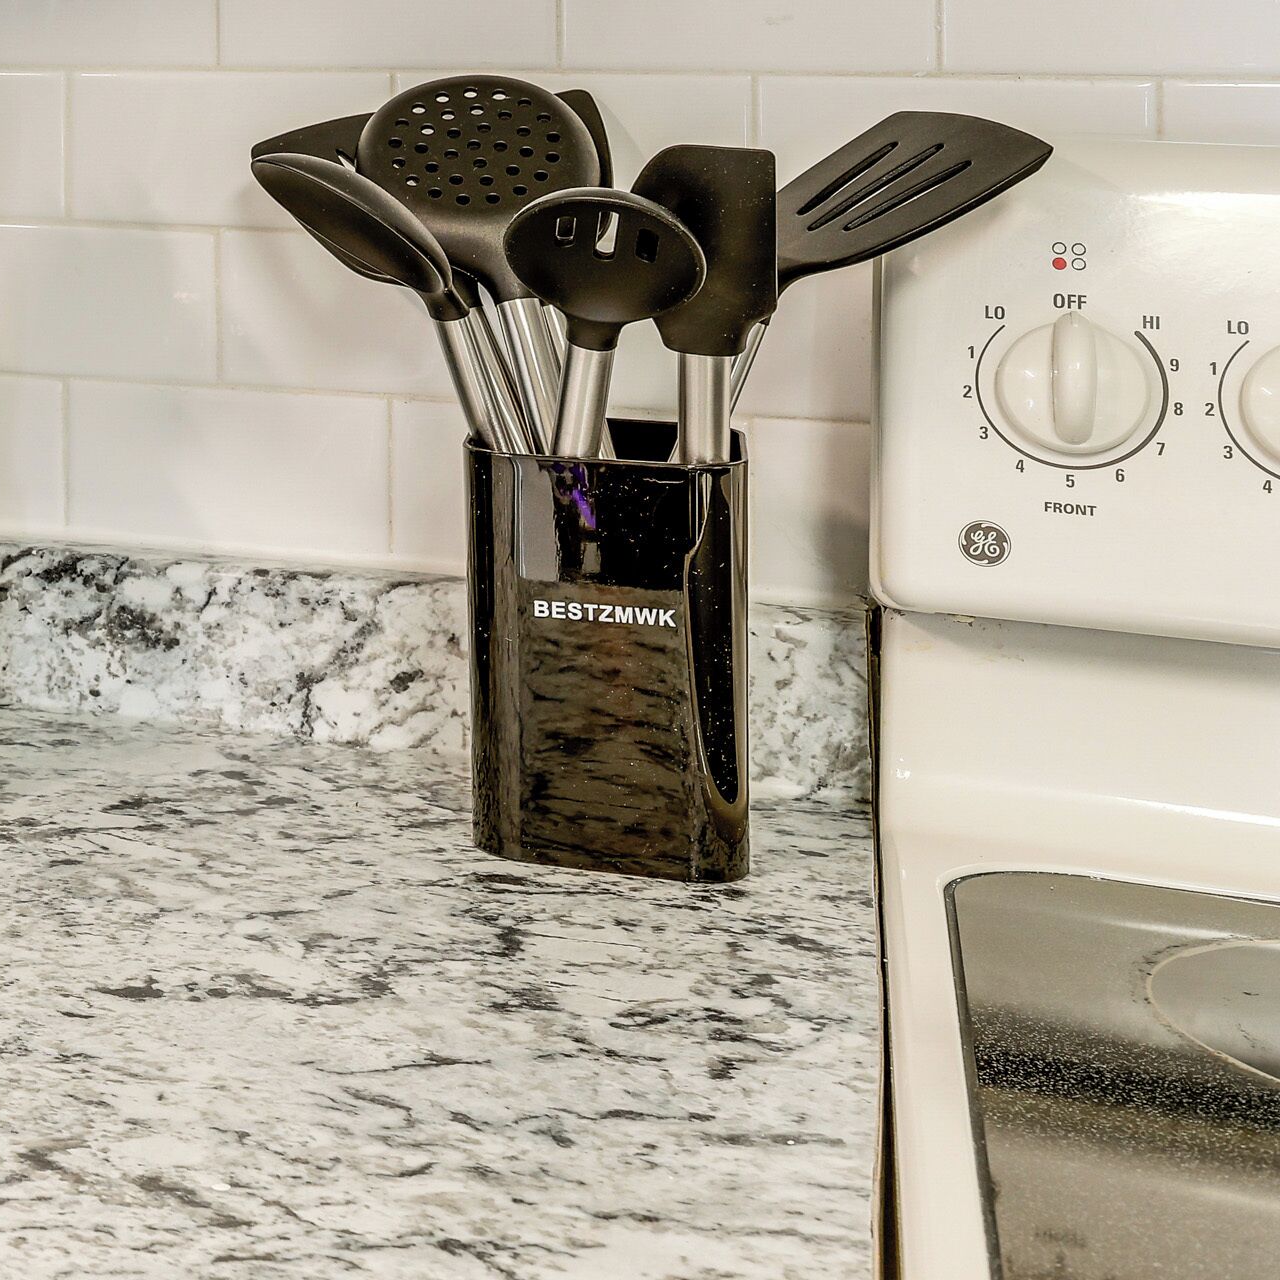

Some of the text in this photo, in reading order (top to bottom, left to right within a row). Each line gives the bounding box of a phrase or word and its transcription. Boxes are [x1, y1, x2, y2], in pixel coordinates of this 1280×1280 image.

[1052, 293, 1088, 310] OFF
[984, 305, 1006, 320] LO
[1142, 315, 1161, 330] HI
[1227, 320, 1250, 335] LO
[967, 346, 975, 359] 1
[1169, 358, 1180, 372] 9
[1209, 362, 1217, 375] 1
[962, 385, 973, 399] 2
[1173, 402, 1184, 416] 8
[1204, 403, 1215, 417] 2
[979, 426, 989, 440] 3
[1156, 442, 1166, 456] 7
[1223, 445, 1233, 460] 3
[1015, 460, 1025, 473] 4
[1065, 474, 1076, 488] 5
[1115, 469, 1125, 483] 6
[1262, 480, 1273, 494] 4
[1044, 501, 1097, 517] FRONT
[533, 600, 677, 627] BESTZMWK
